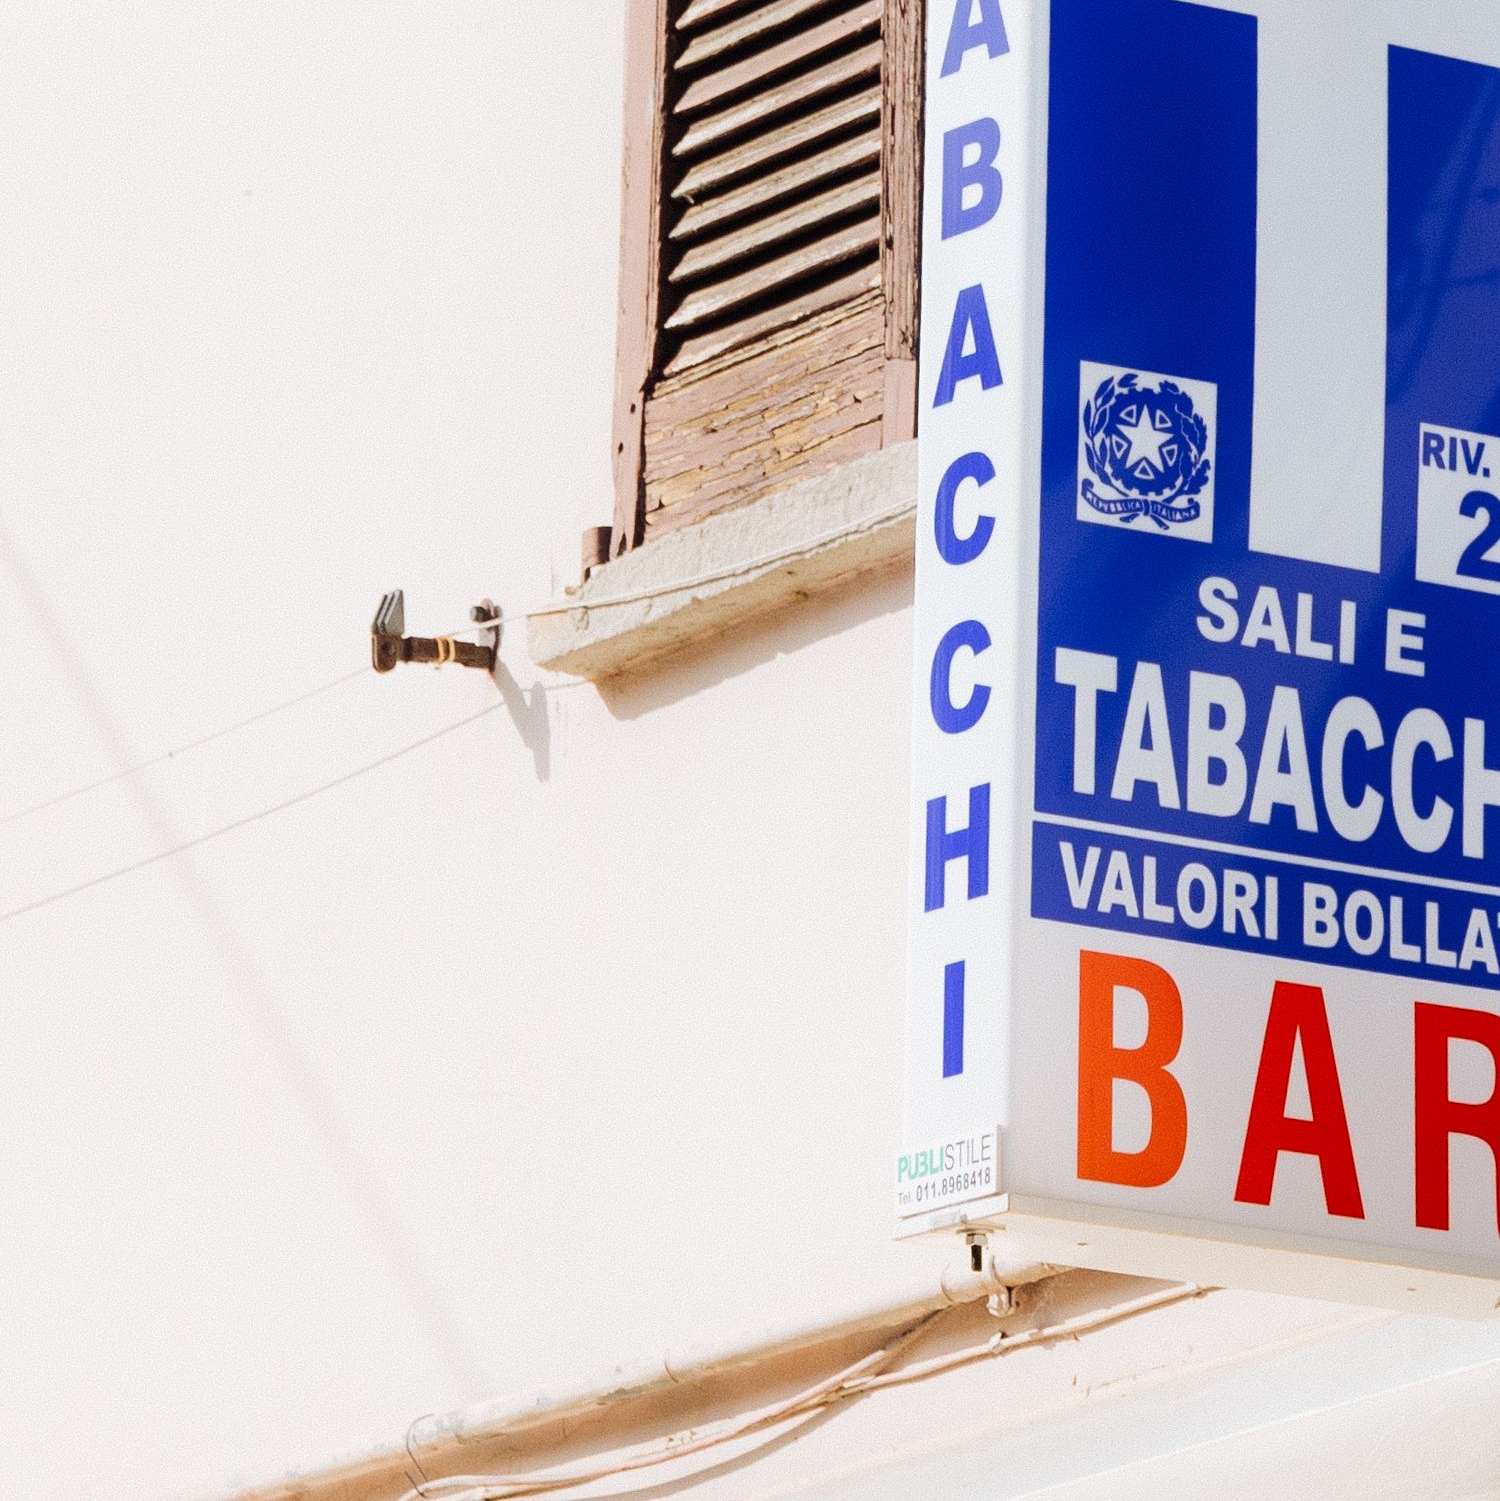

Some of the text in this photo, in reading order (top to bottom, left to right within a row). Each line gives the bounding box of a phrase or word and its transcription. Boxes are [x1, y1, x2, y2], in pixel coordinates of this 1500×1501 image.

[1421, 431, 1491, 478] RIV.
[1196, 576, 1426, 677] SALI E
[1058, 840, 1279, 941] VALORI
[897, 1134, 991, 1183] PUBLISTILE
[916, 1167, 991, 1202] 011.8968418
